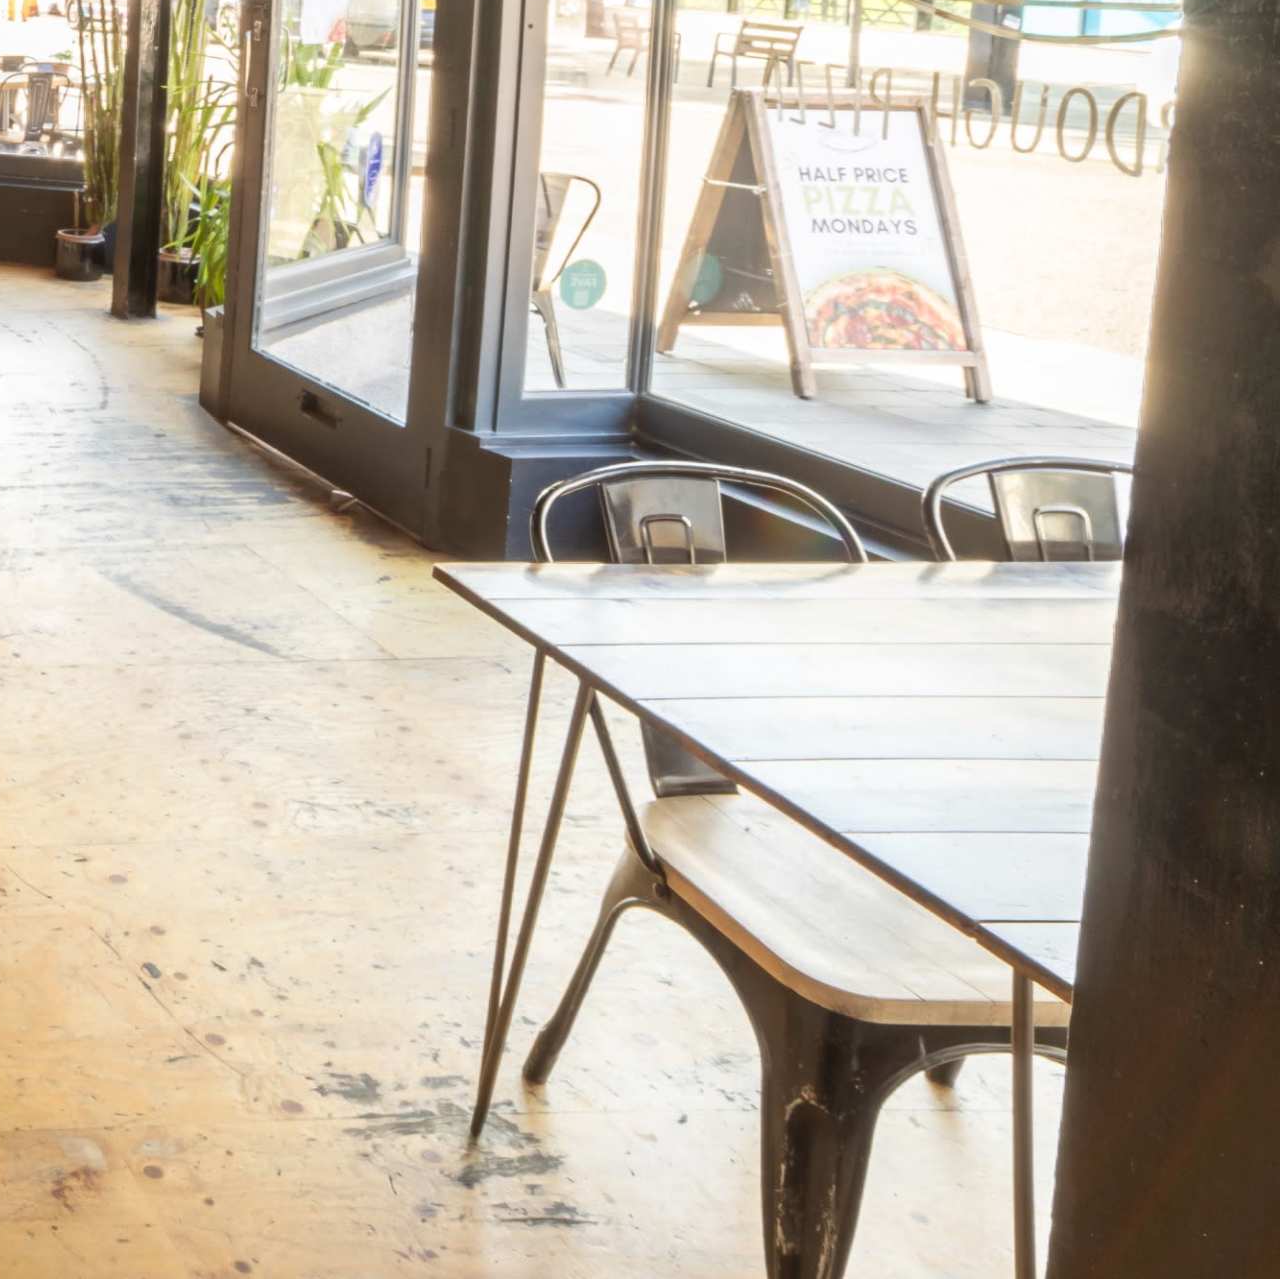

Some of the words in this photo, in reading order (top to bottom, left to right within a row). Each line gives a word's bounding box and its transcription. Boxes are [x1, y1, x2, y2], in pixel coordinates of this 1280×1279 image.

[799, 167, 847, 183] HALF
[855, 168, 910, 183] PRICE
[802, 186, 914, 216] PIZZA
[811, 218, 918, 236] MONDAYS
